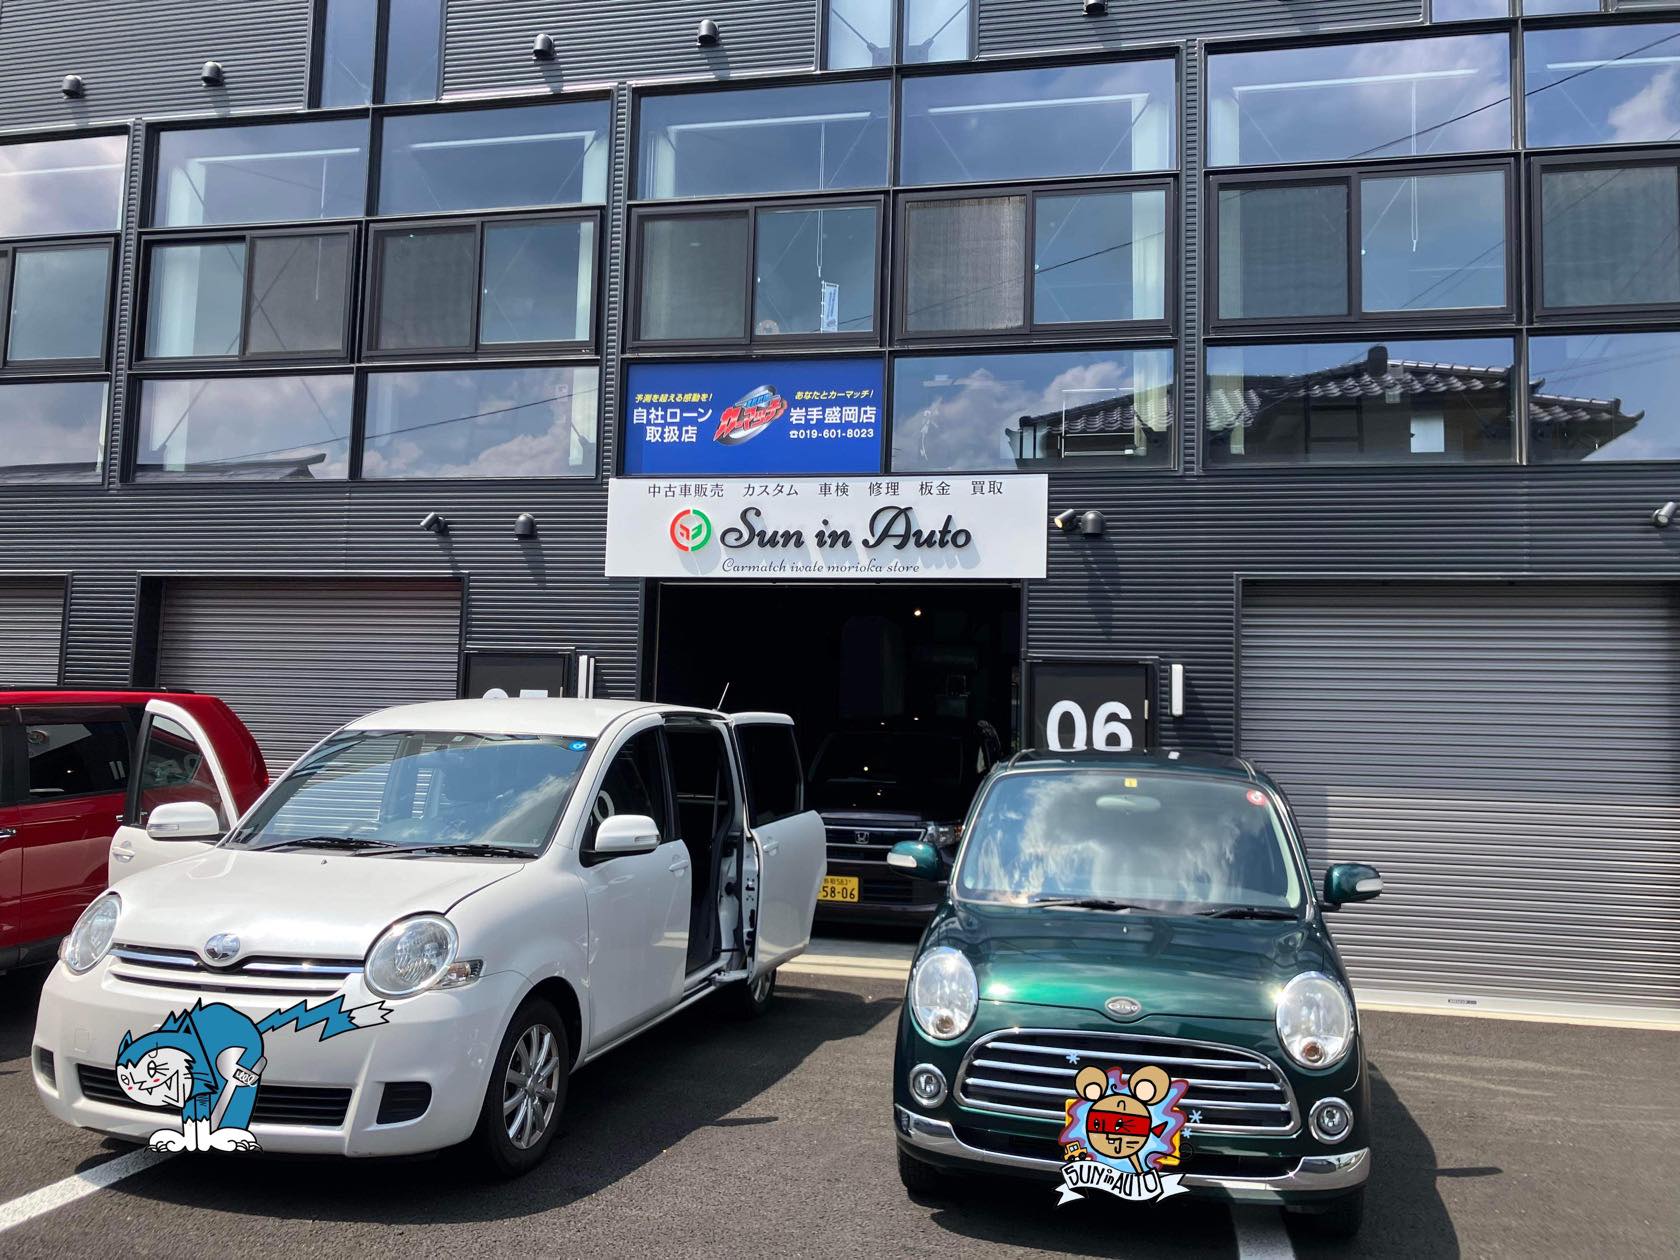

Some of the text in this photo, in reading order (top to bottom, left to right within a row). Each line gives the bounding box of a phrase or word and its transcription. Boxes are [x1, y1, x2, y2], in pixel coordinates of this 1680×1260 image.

[633, 407, 713, 424] 自社ローン
[789, 406, 877, 424] 岩手盛岡店
[645, 425, 698, 442] 取扱店
[798, 428, 874, 439] 019-601-8023
[648, 480, 1003, 498] 中古車販売 カスタム 車検 修理 板金 買取
[720, 505, 972, 551] Sun in Auto
[722, 557, 920, 573] Carmatch iwate morioka store
[1046, 700, 1133, 751] 06
[822, 885, 856, 899] 58-06
